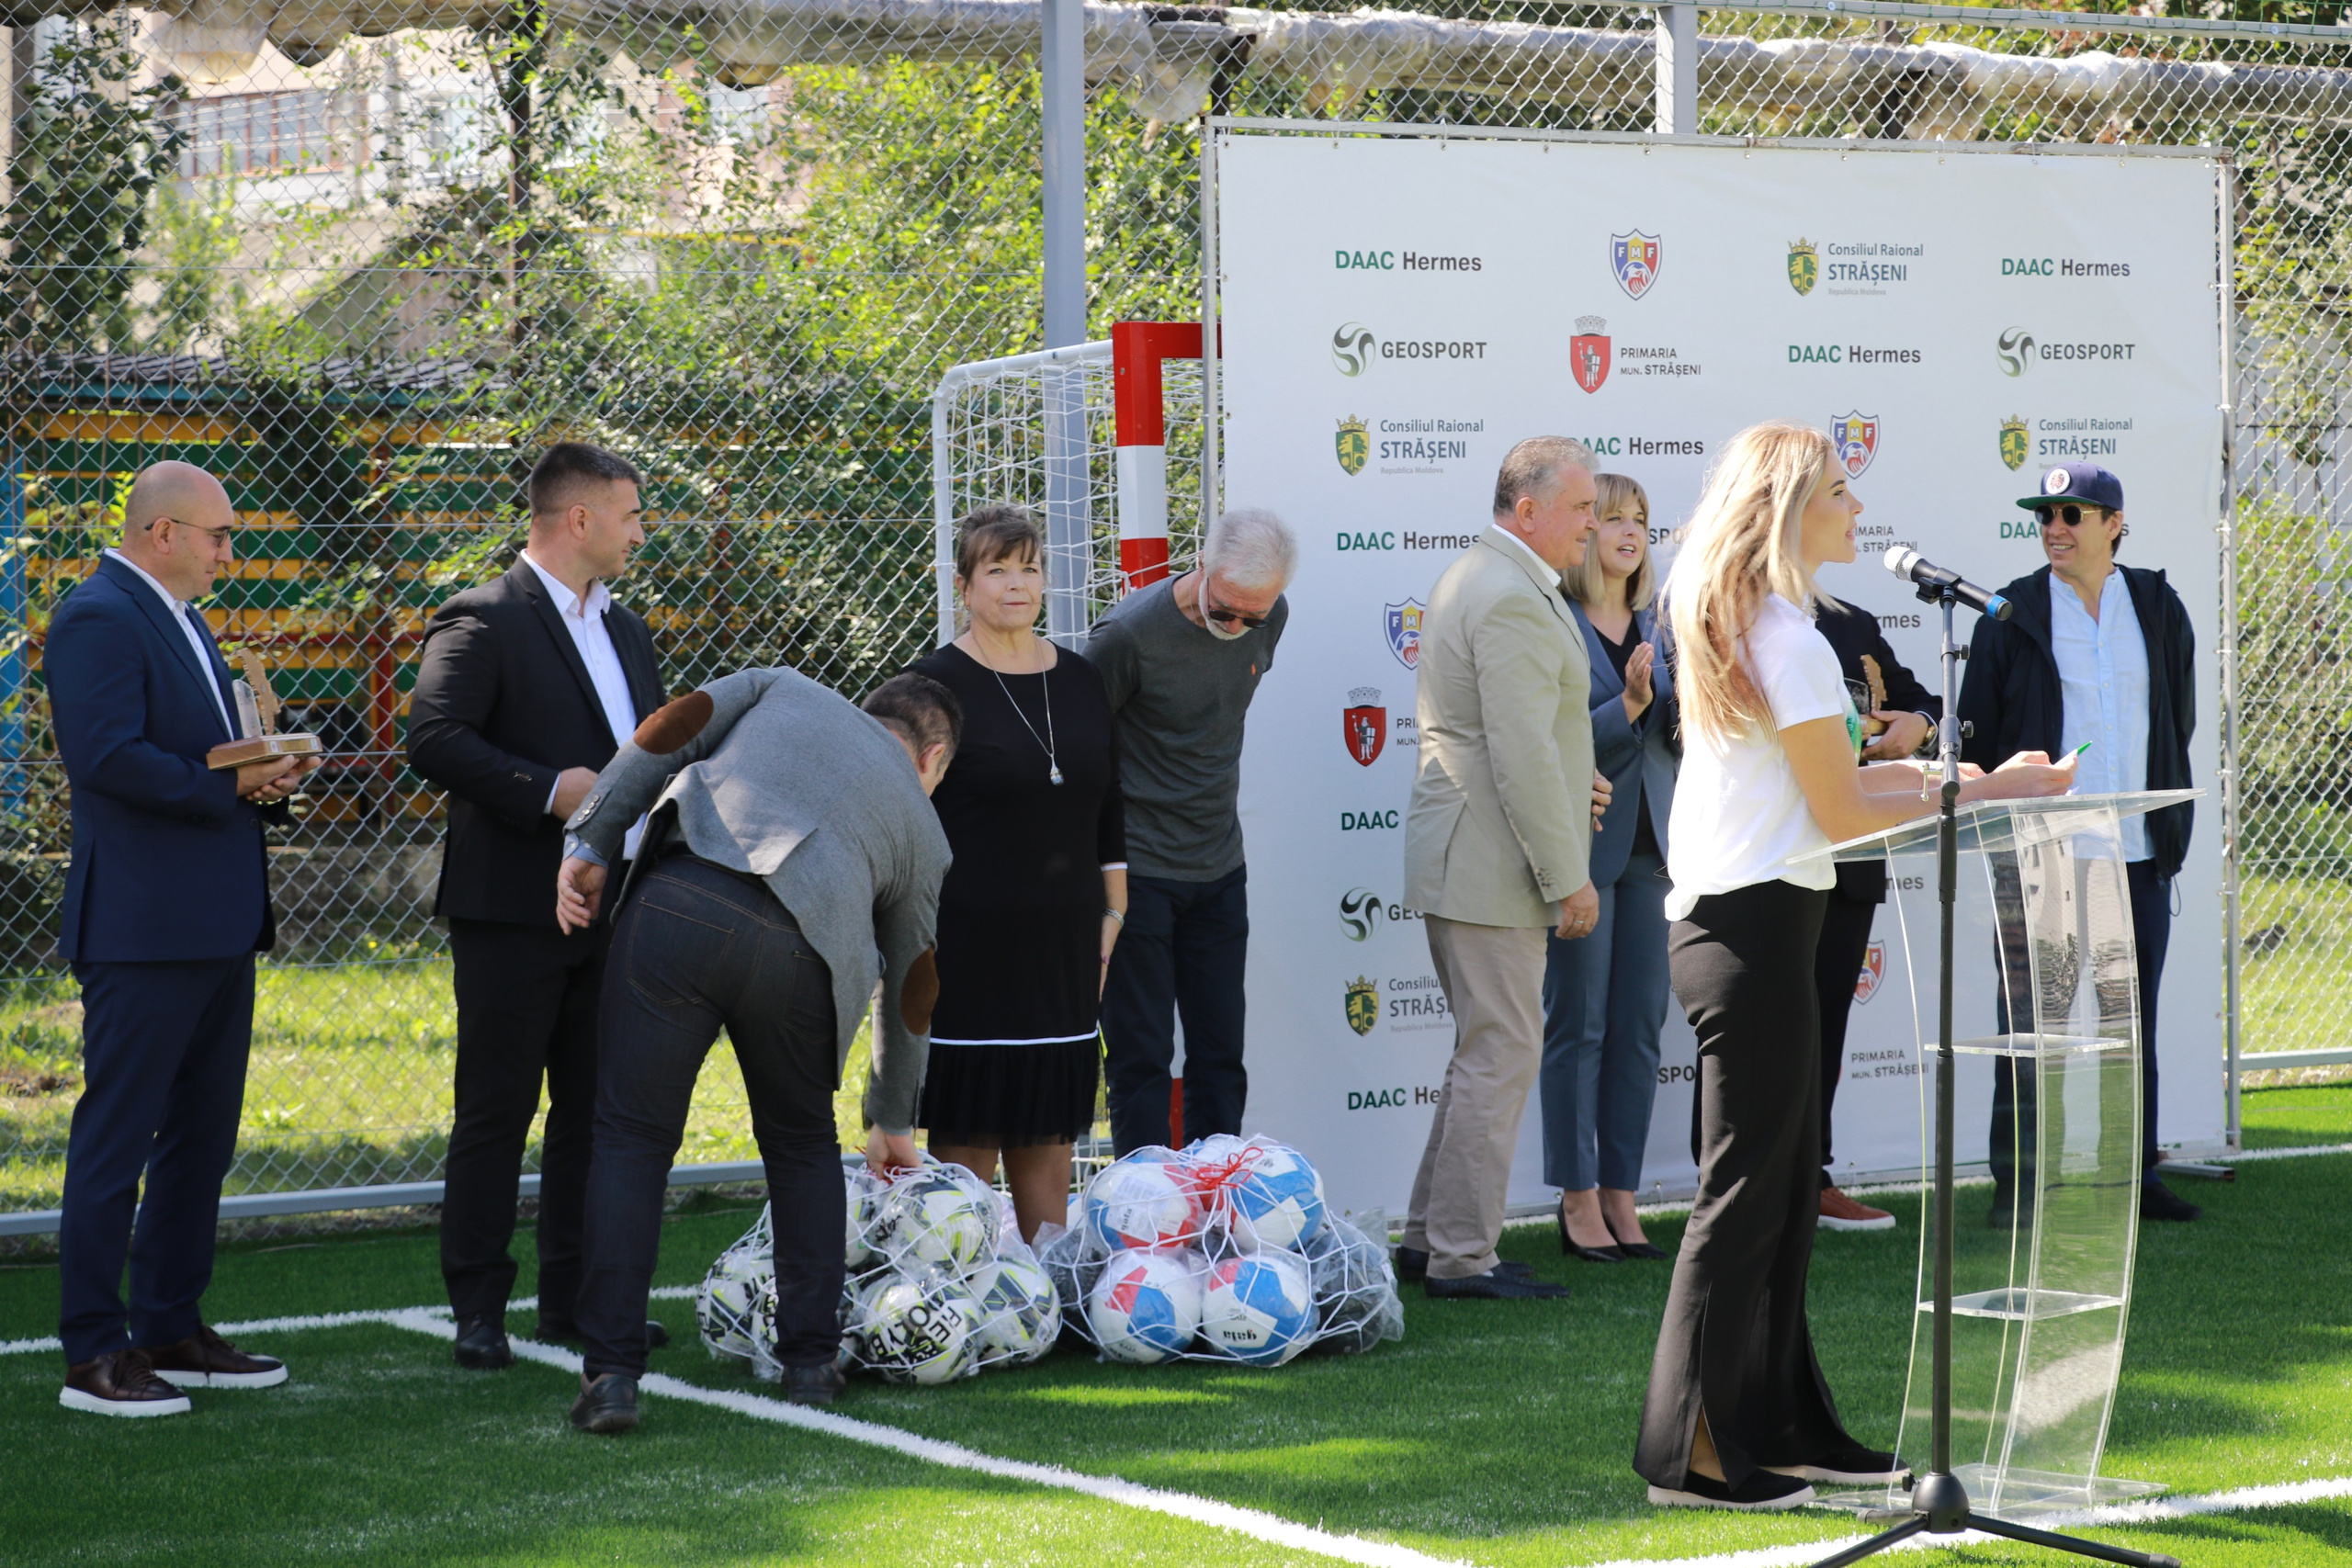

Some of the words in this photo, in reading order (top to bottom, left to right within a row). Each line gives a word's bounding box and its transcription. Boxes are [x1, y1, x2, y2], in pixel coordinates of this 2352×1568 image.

[1617, 246, 1655, 259] FMF
[1828, 243, 1878, 256] Consiliul
[1880, 243, 1924, 257] Raional
[1336, 250, 1395, 270] DAAC
[1403, 251, 1482, 272] Hermes
[2001, 257, 2054, 276] DAAC
[2061, 258, 2131, 277] Hermes
[1381, 341, 1487, 359] GEOSPORT
[1621, 347, 1678, 359] PRIMARIA
[1788, 344, 1842, 364] DAAC
[1849, 344, 1921, 364] Hermes
[2041, 344, 2136, 361] GEOSPORT
[1621, 367, 1642, 376] MUN.
[1380, 418, 1434, 433] Consiliul
[1437, 418, 1484, 433] Raional
[1838, 426, 1874, 439] FMF
[2039, 418, 2087, 432] Consiliul
[2090, 417, 2133, 431] Raional
[1629, 436, 1704, 456] Hermes
[2000, 522, 2044, 539] DAA
[1337, 531, 1396, 551] DAAC
[1340, 809, 1399, 831] DAAC
[1389, 976, 1442, 992] Consiliu
[1851, 1050, 1905, 1064] PRIMARIA
[1348, 1088, 1407, 1111] DAAC
